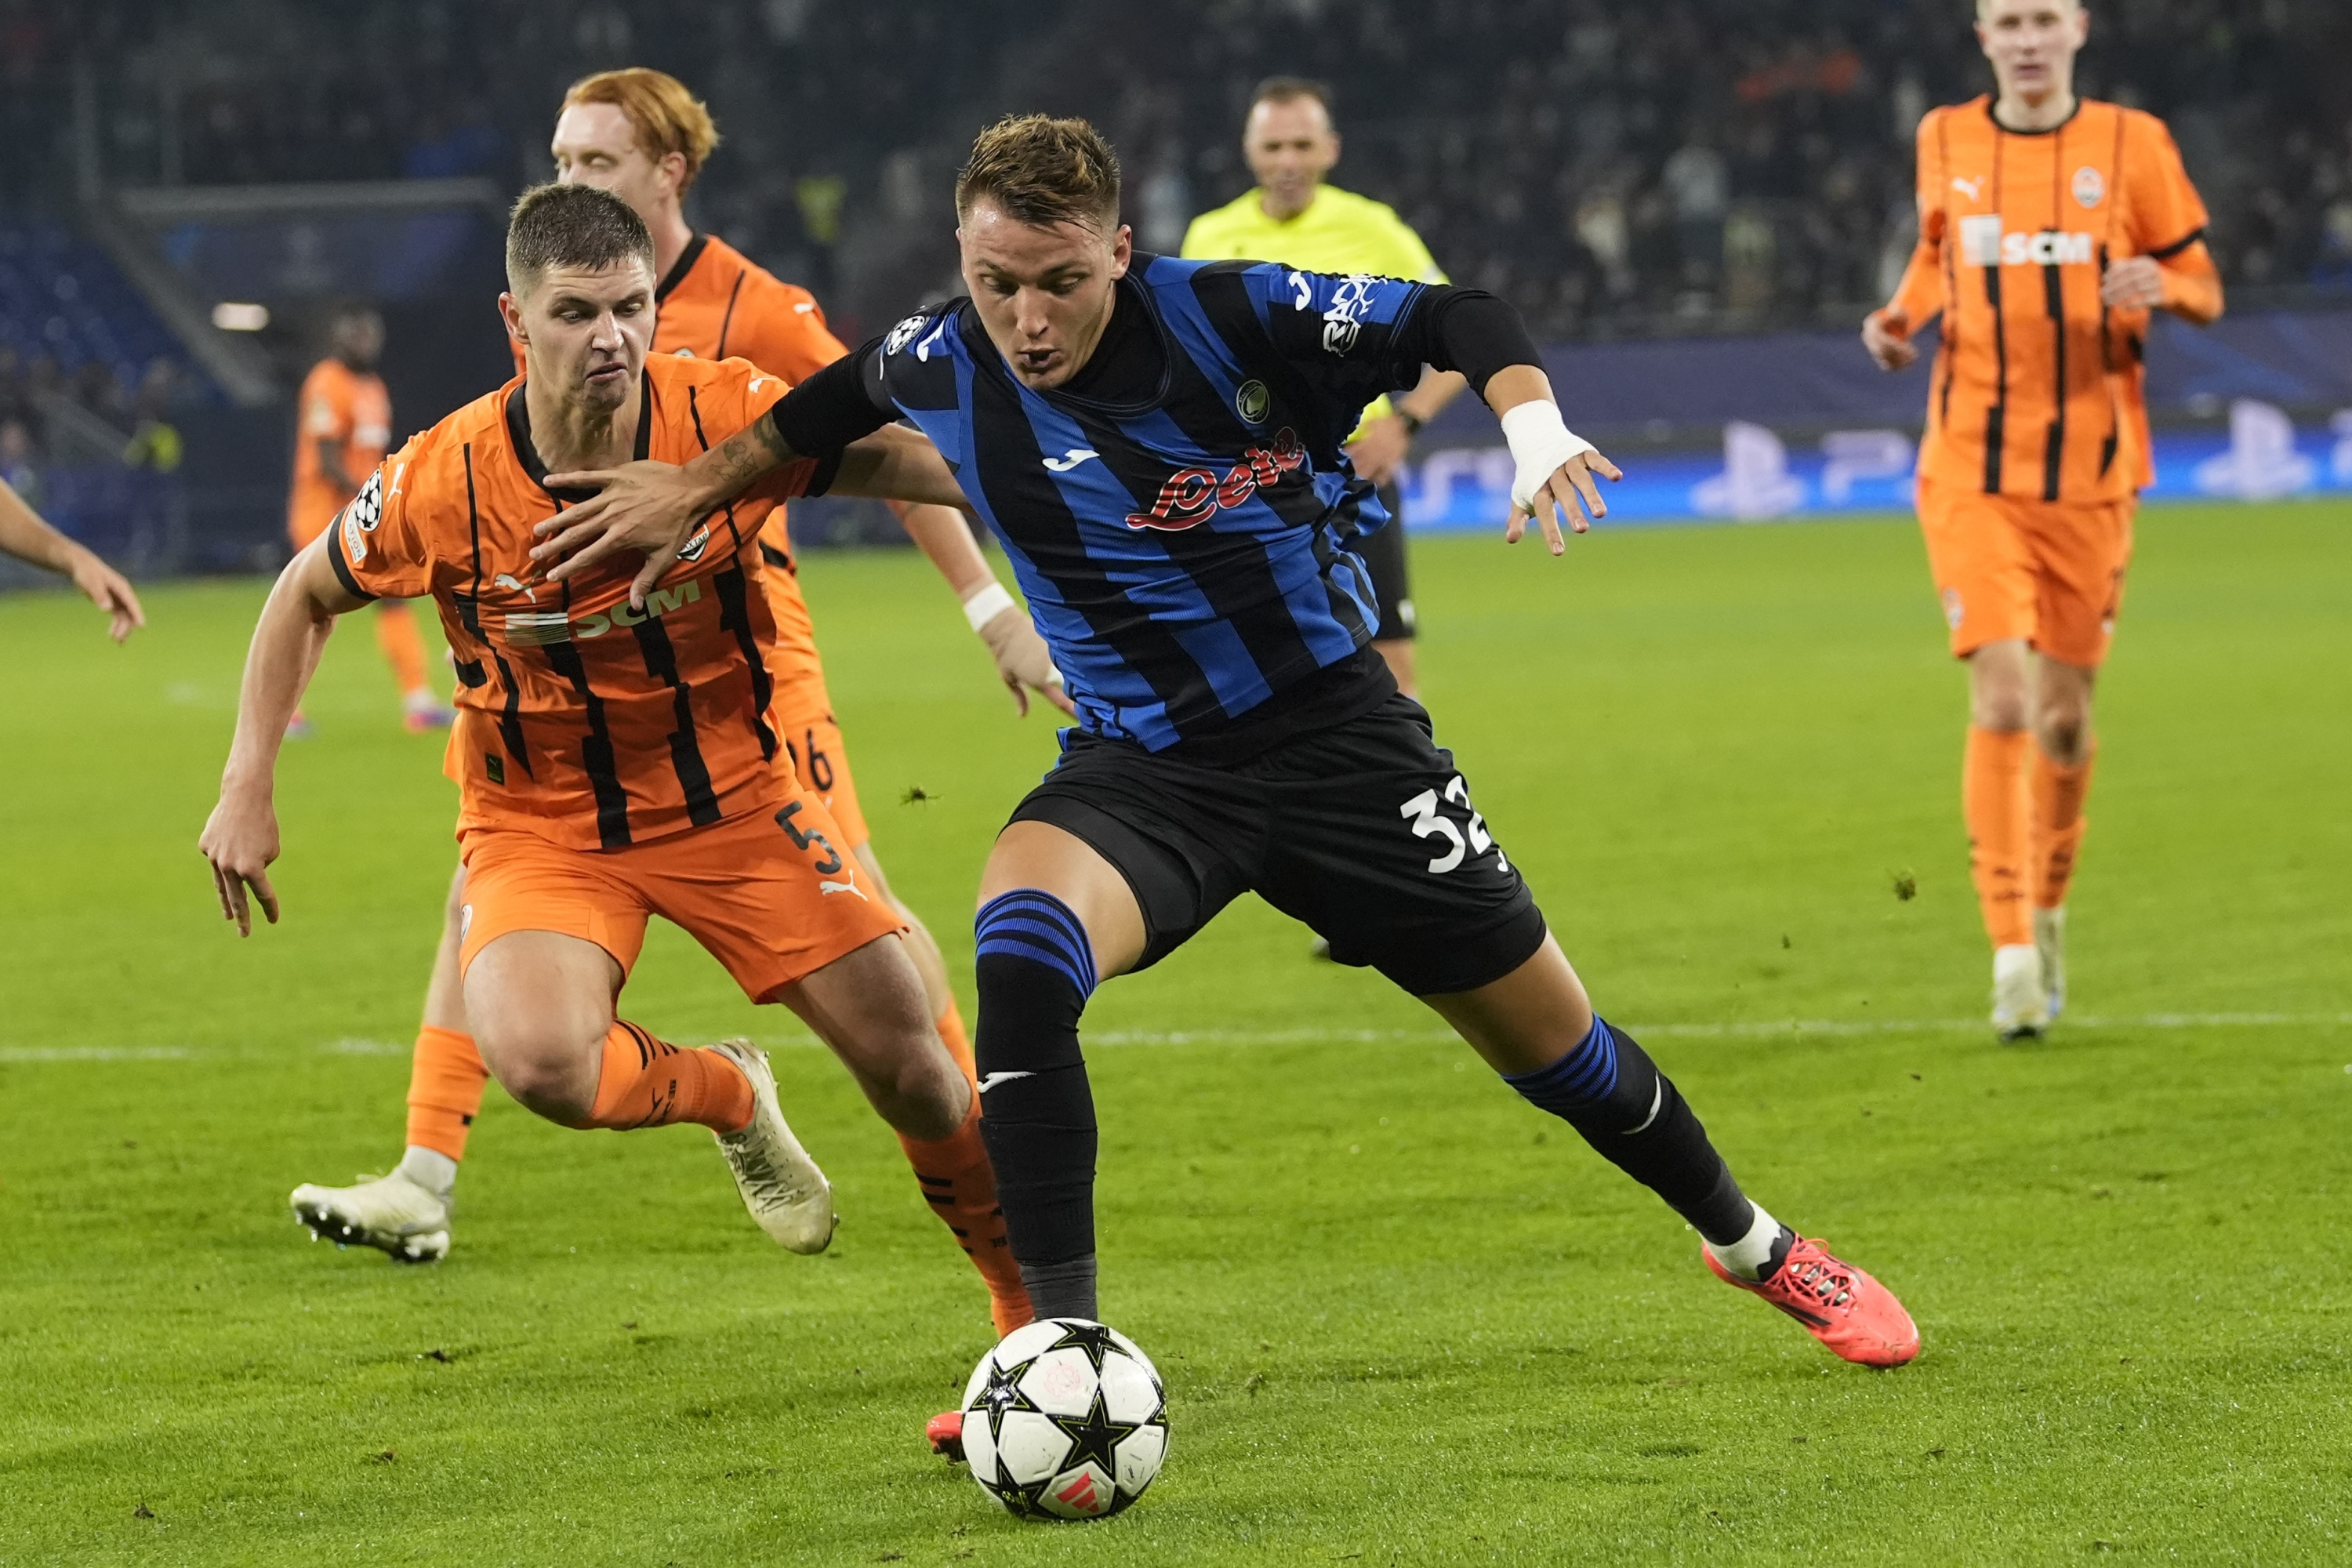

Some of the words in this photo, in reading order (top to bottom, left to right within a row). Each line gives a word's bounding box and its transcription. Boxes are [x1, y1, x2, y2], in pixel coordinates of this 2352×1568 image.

[2002, 231, 2092, 266] SCM
[575, 579, 702, 638] SCM
[774, 800, 843, 875] 5
[1399, 775, 1492, 874] 32
